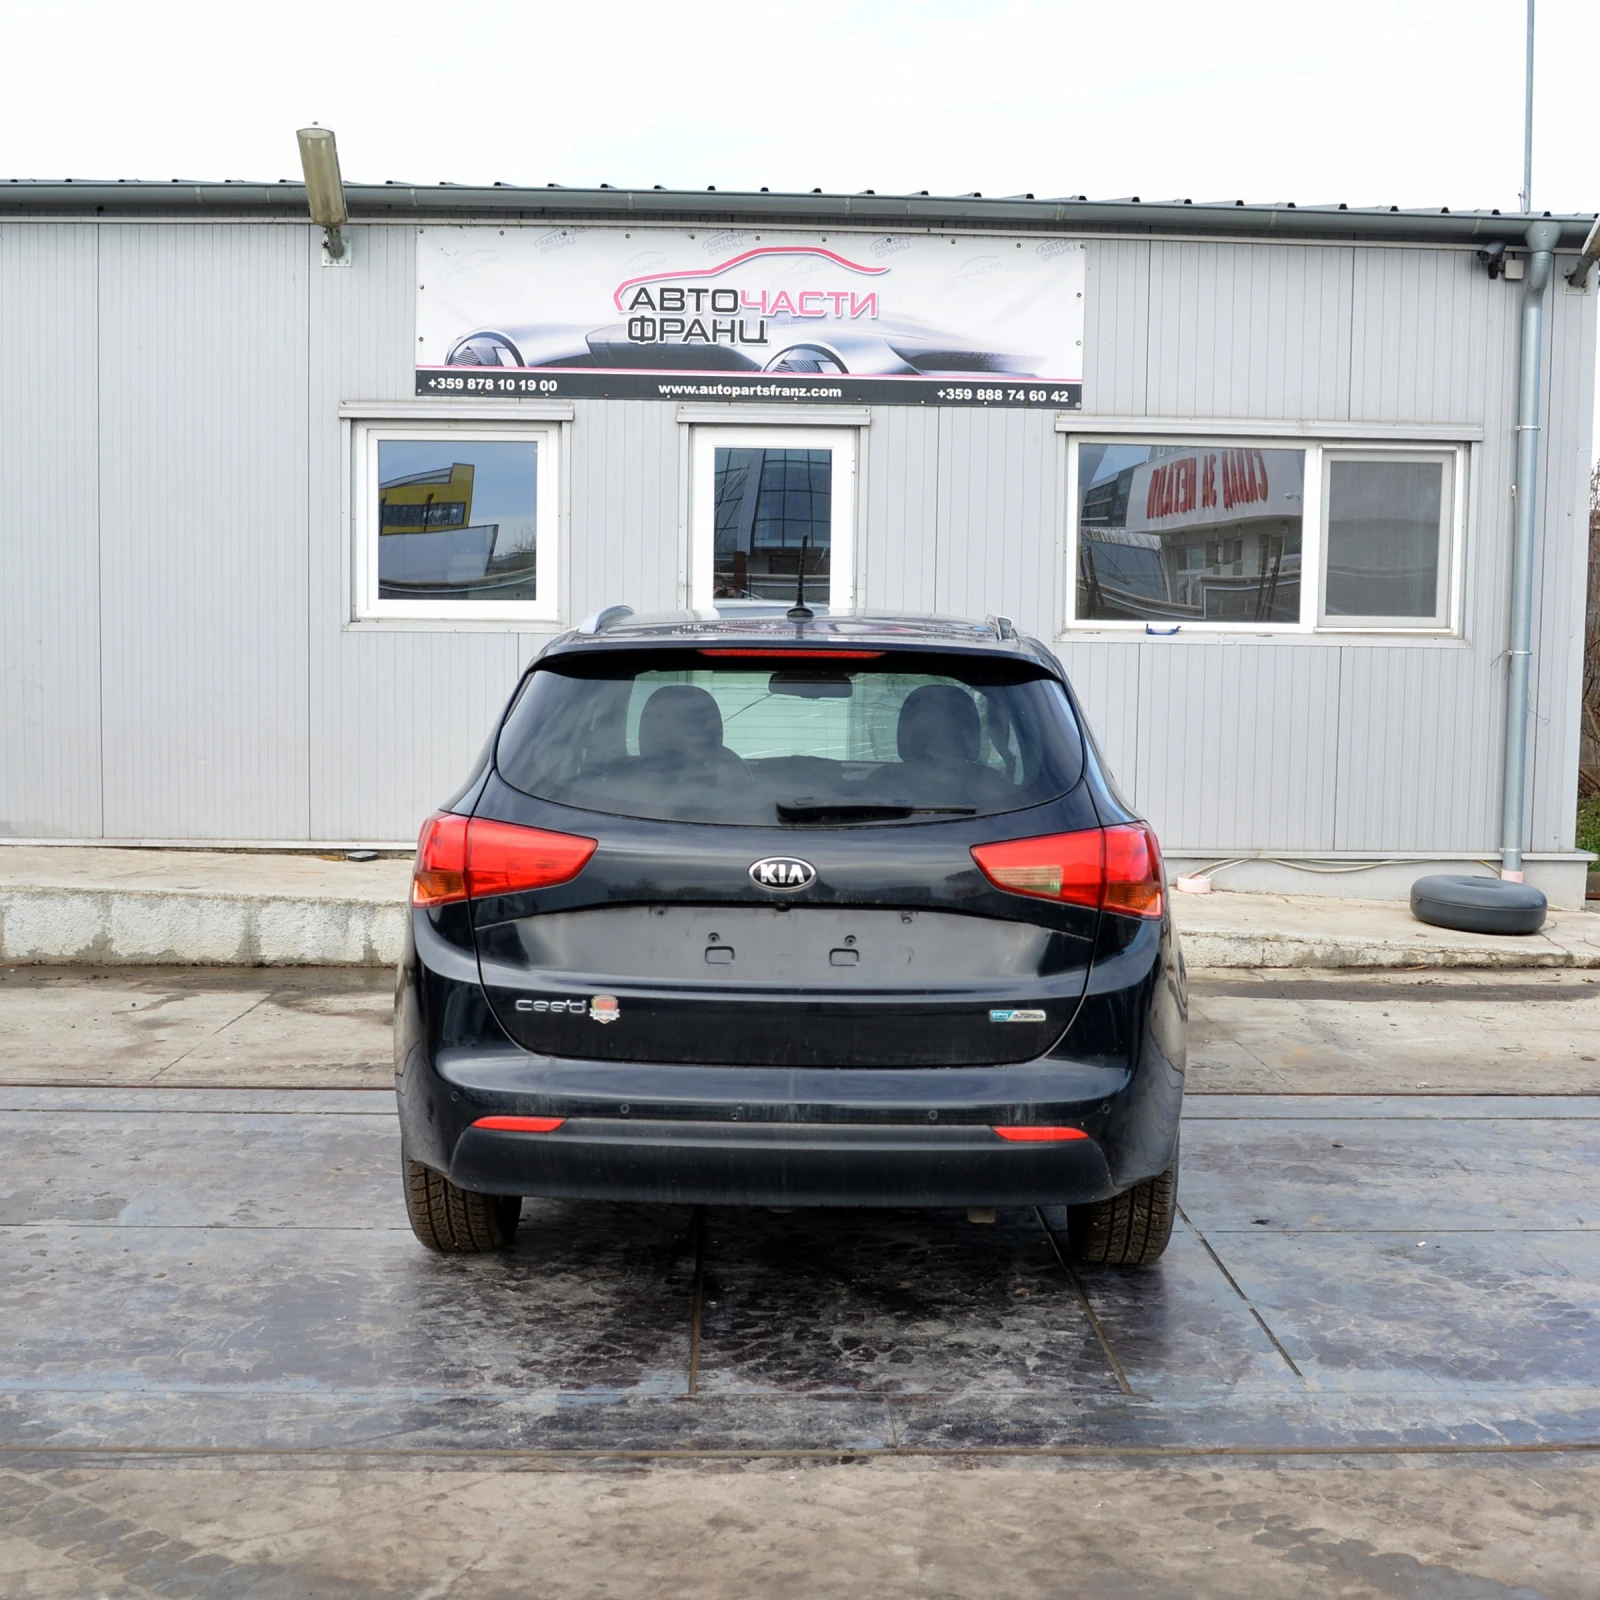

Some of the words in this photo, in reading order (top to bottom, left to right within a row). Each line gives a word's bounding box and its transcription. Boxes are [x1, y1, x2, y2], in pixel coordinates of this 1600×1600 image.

[628, 287, 878, 317] АВТОЧАСТИ
[627, 315, 769, 344] ФРАНЦ
[428, 378, 464, 390] +359
[467, 378, 494, 390] 878
[498, 379, 515, 390] 10
[519, 379, 536, 391] 19
[540, 380, 558, 391] 00
[658, 383, 842, 398] www.autopartsfranz.com
[937, 388, 973, 400] +359
[976, 389, 1003, 400] 888
[1007, 390, 1025, 401] 74
[1028, 390, 1047, 401] 60
[1050, 391, 1069, 402] 42
[760, 864, 805, 883] KIA
